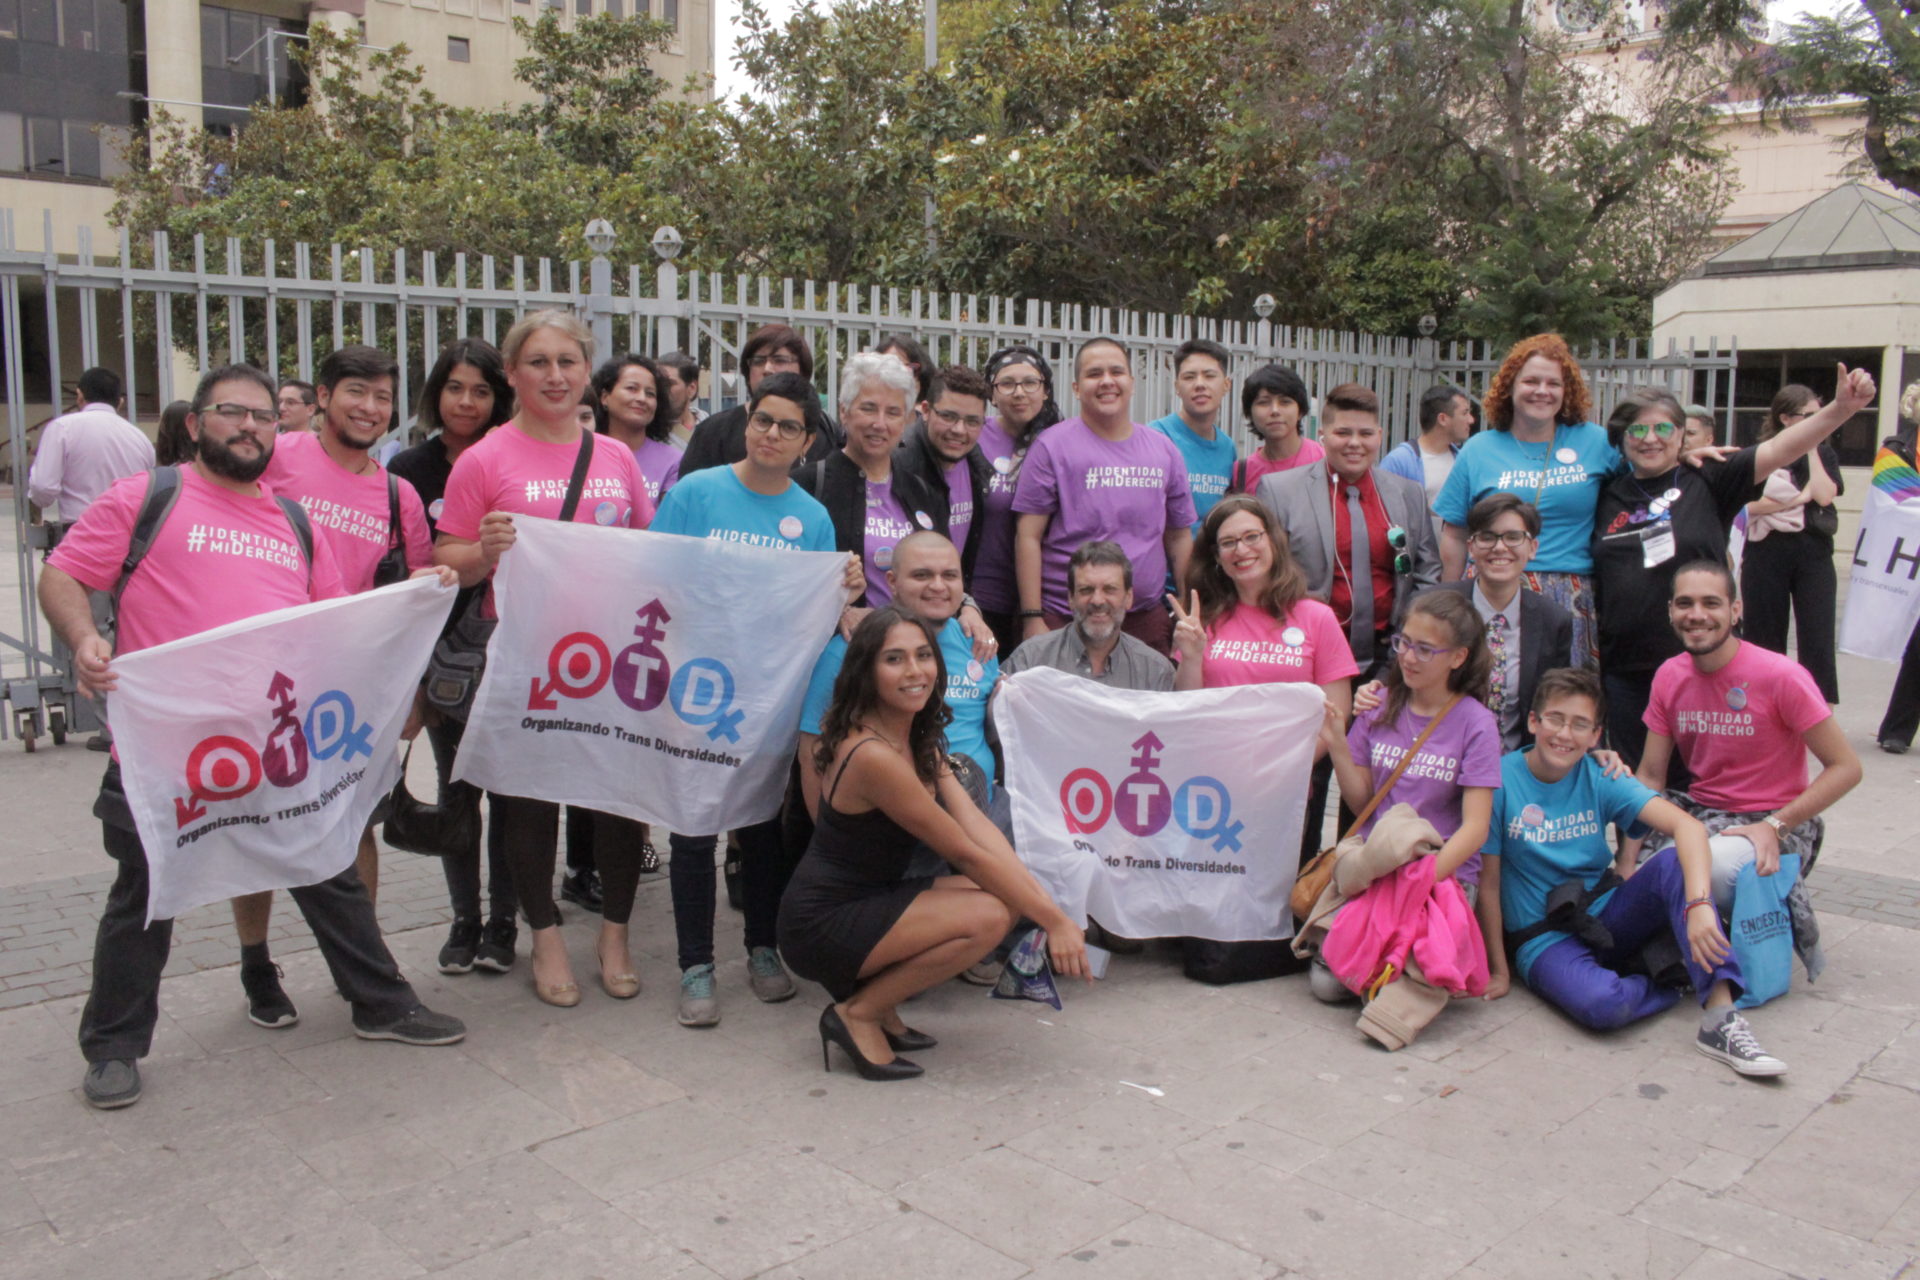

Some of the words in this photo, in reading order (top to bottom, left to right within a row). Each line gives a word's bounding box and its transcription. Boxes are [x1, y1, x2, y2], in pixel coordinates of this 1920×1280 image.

[1085, 466, 1163, 489] #IDENTIDAD
[1498, 464, 1584, 489] #IDENTIDAD
[525, 478, 622, 503] #IDEIDAD
[187, 524, 299, 557] #IDENTIDAD
[1210, 639, 1303, 659] #IDENTIDAD
[521, 716, 610, 736] Organizando
[614, 726, 651, 747] Trans
[654, 738, 742, 768] Diversidades
[1371, 742, 1456, 769] #IDETIDAD
[1382, 756, 1454, 782] MIERECHO
[1124, 856, 1161, 870] Trans
[1165, 857, 1247, 875] Diversidades
